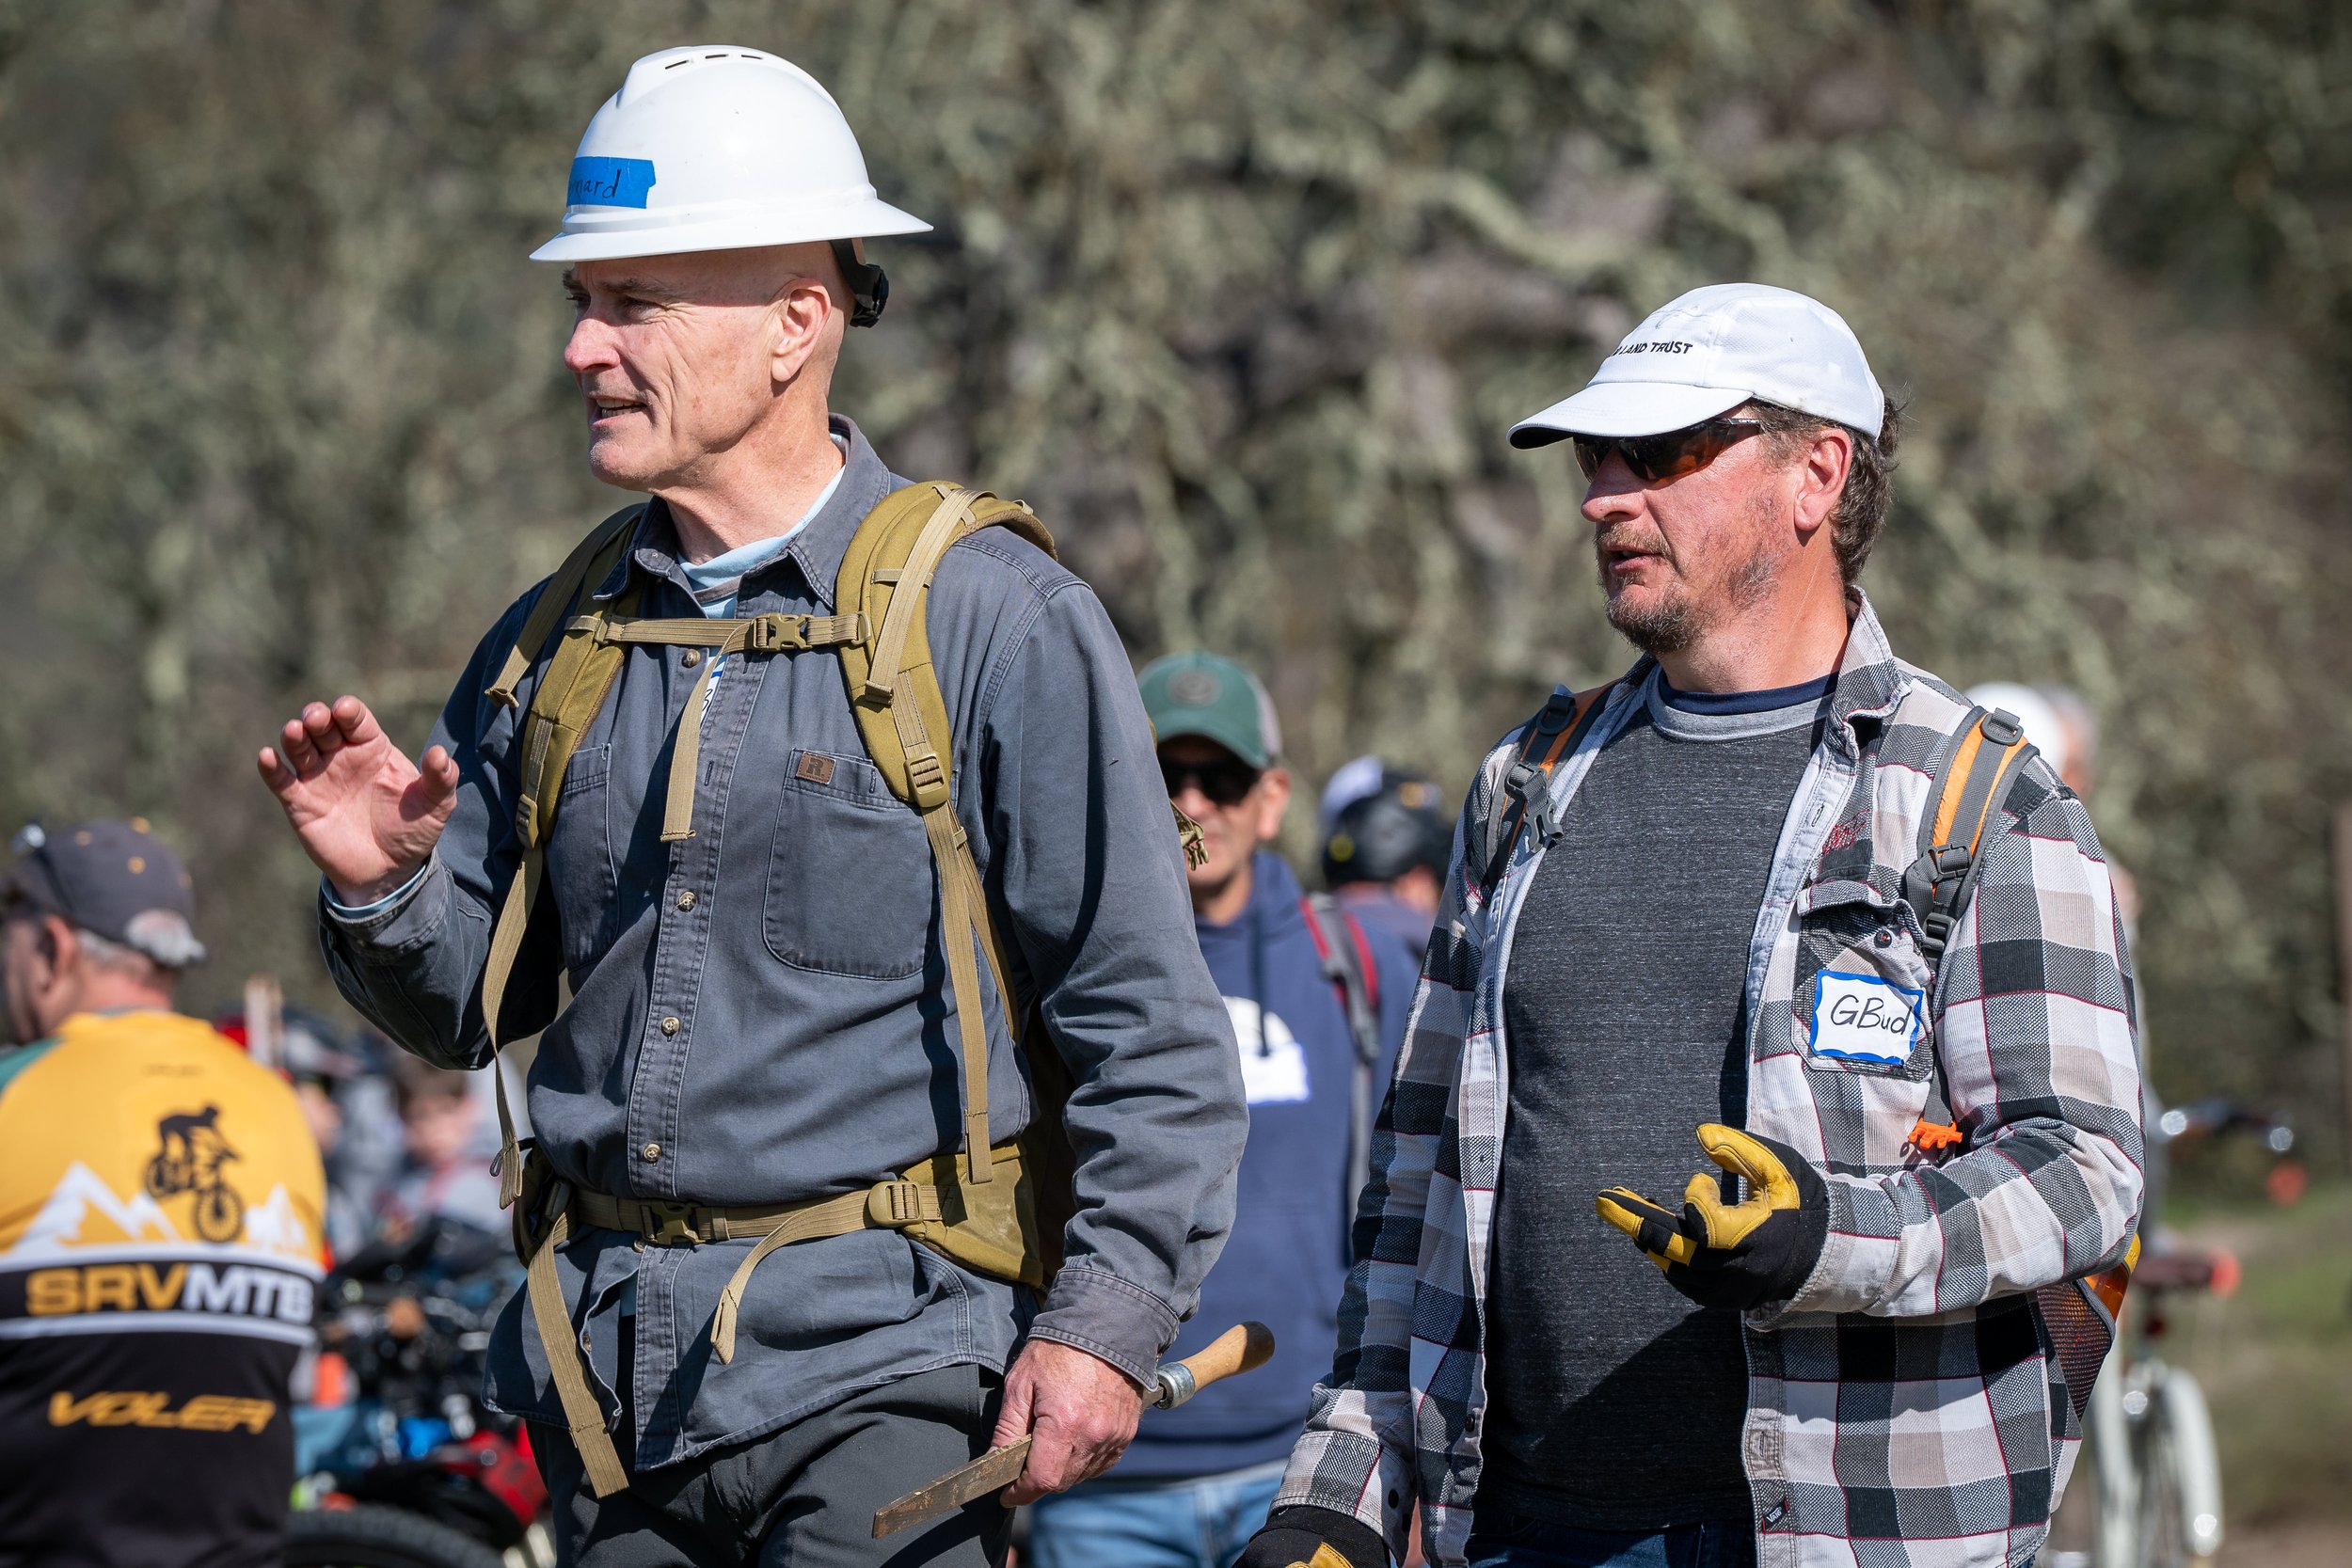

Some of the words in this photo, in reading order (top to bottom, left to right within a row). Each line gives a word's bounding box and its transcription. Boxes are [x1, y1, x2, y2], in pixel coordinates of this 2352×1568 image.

[1618, 342, 1648, 356] LAND
[1650, 341, 1693, 355] TRUST
[1830, 993, 1913, 1036] GBud
[49, 1390, 277, 1434] VOLER
[1766, 1507, 1782, 1523] VANS
